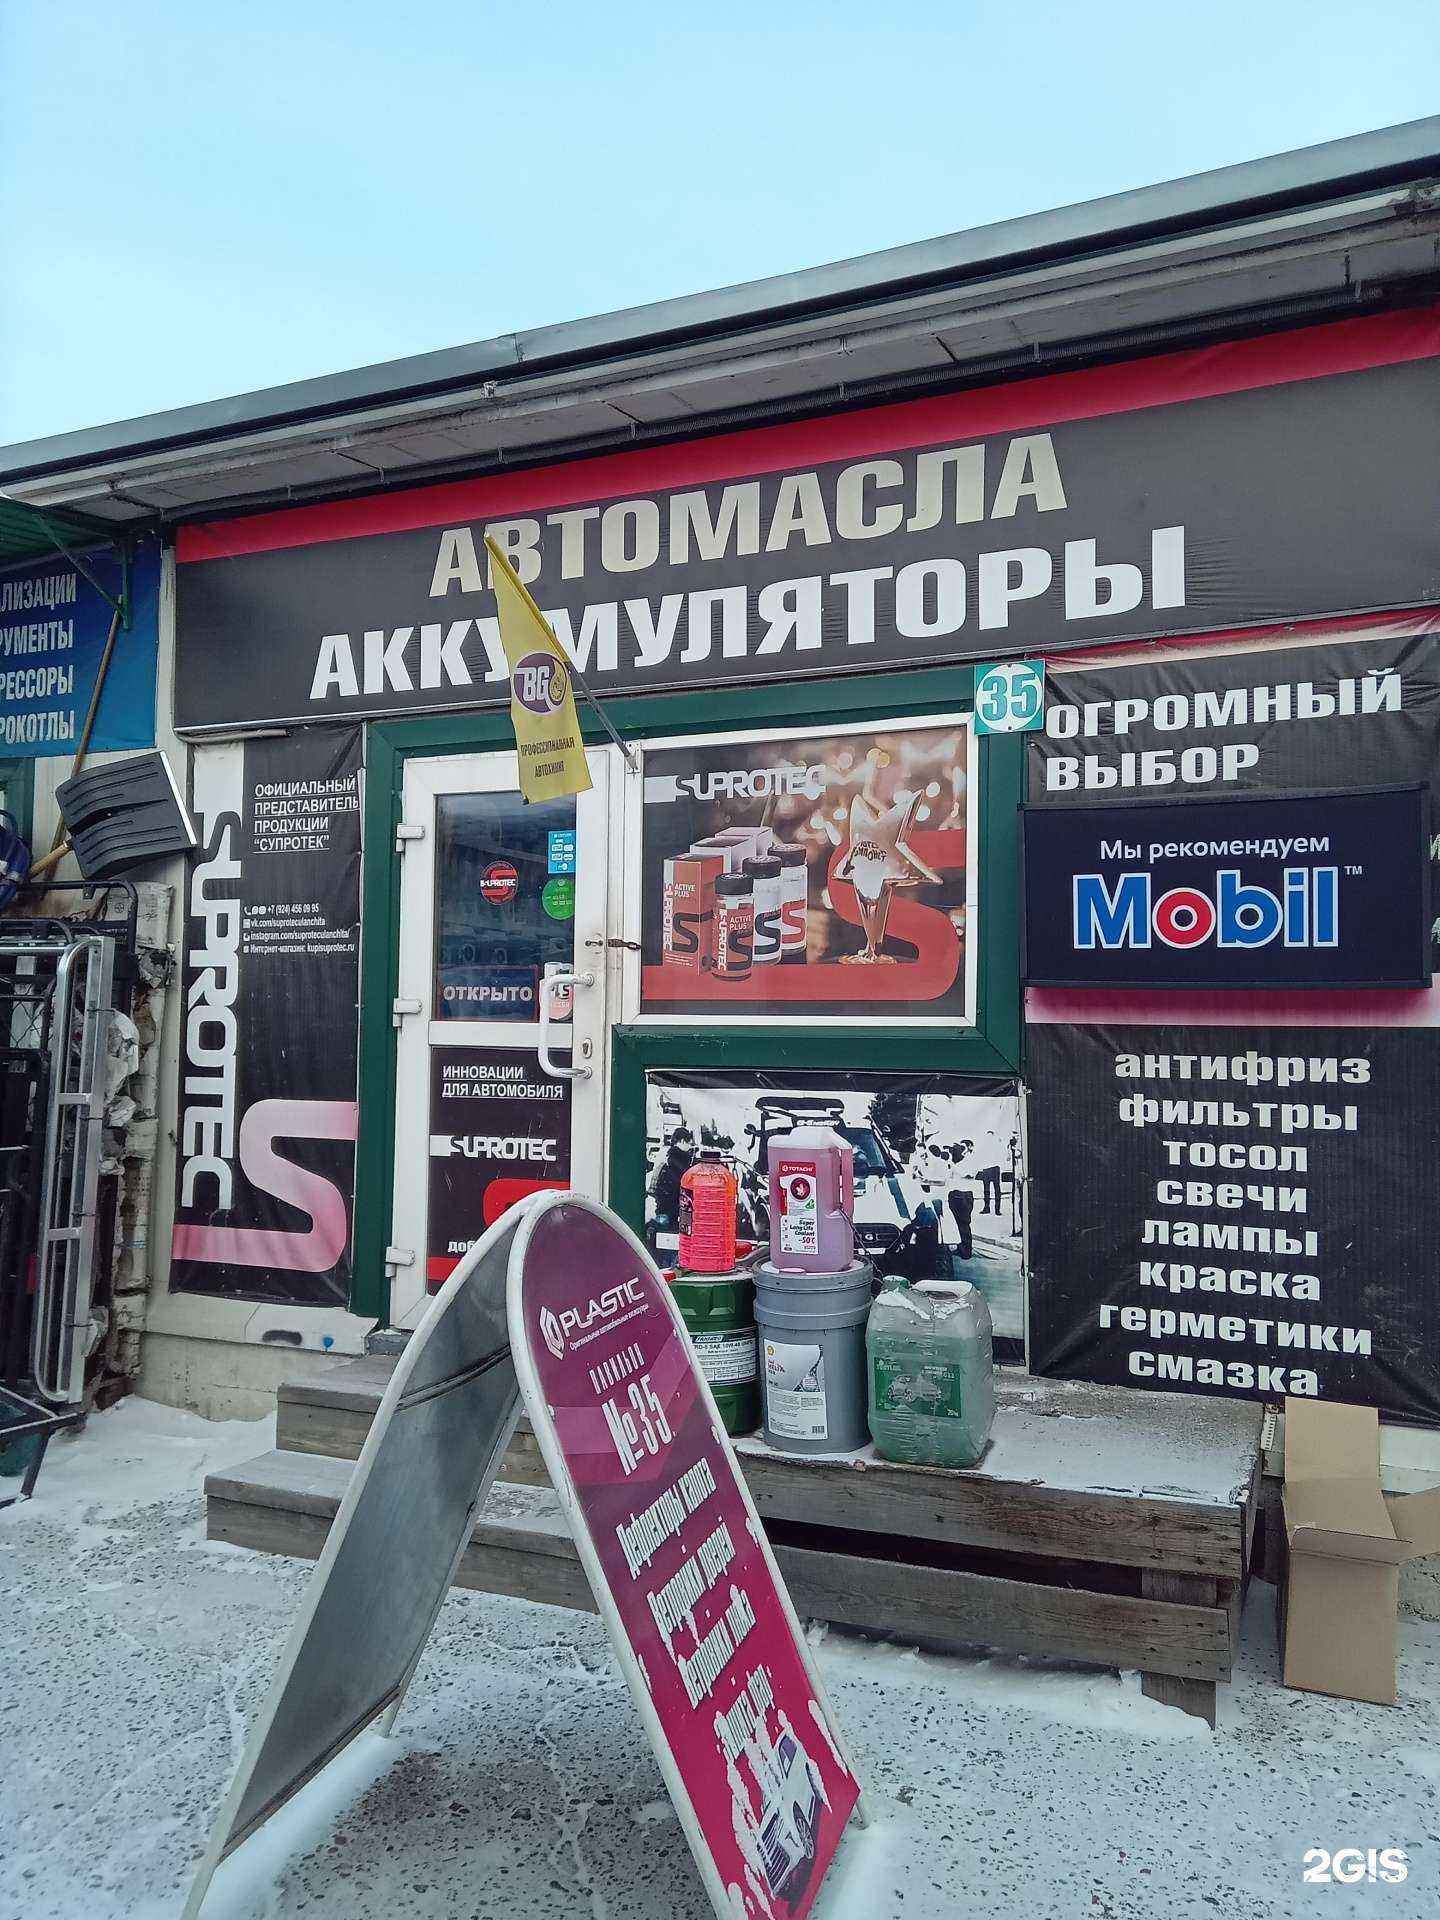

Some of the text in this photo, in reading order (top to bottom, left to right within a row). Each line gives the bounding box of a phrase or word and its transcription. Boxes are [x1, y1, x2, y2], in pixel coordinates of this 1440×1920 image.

[429, 432, 1067, 597] АВТОМАСЛА
[0, 573, 77, 612] ЛИЗАЦИИ
[515, 665, 551, 702] BG
[980, 671, 1038, 721] 35
[1045, 667, 1402, 739] ОГРОМНЫЙ
[520, 737, 576, 757] ПРОФЕССИОНАЛЬНАЯ
[254, 775, 357, 797] ОФИЦИАЛЬНЫЙ
[534, 761, 565, 778] АВТОХИМИЯ
[675, 764, 828, 801] SUPROTEC
[1045, 744, 1260, 792] ВЫБОР
[254, 797, 359, 816] ПРЕДСТАВИТЕЛЬ
[254, 817, 329, 834] ПРОДУКЦИИ
[1100, 836, 1330, 863] Мы рекомендуем
[674, 883, 696, 892] ACTIVE
[674, 890, 690, 898] PLUS
[729, 915, 752, 924] ACTIVE
[1072, 867, 1339, 949] Mobil
[181, 810, 243, 1211] SUPROTEC
[443, 986, 533, 1002] ОТКРЫТО
[442, 1065, 524, 1083] ИННОВАЦИИ
[1115, 1050, 1371, 1087] антифриз
[442, 1083, 563, 1098] ДЛЯ АВТОМОБИЛЯ
[1119, 1093, 1358, 1134] фильтры
[450, 1135, 557, 1161] SUPROTEC
[1162, 1140, 1308, 1173] тосол
[1156, 1180, 1307, 1213] свечи
[1141, 1219, 1318, 1256] лампы
[1139, 1260, 1320, 1301] краска
[558, 1277, 645, 1338] PLASTIC
[1099, 1304, 1372, 1356] герметики
[588, 1342, 646, 1395] ПАВИЛЬОН
[1128, 1351, 1319, 1396] смазка
[615, 1457, 717, 1580] Дефлекторы капота
[647, 1515, 737, 1634] Ветровики дверей
